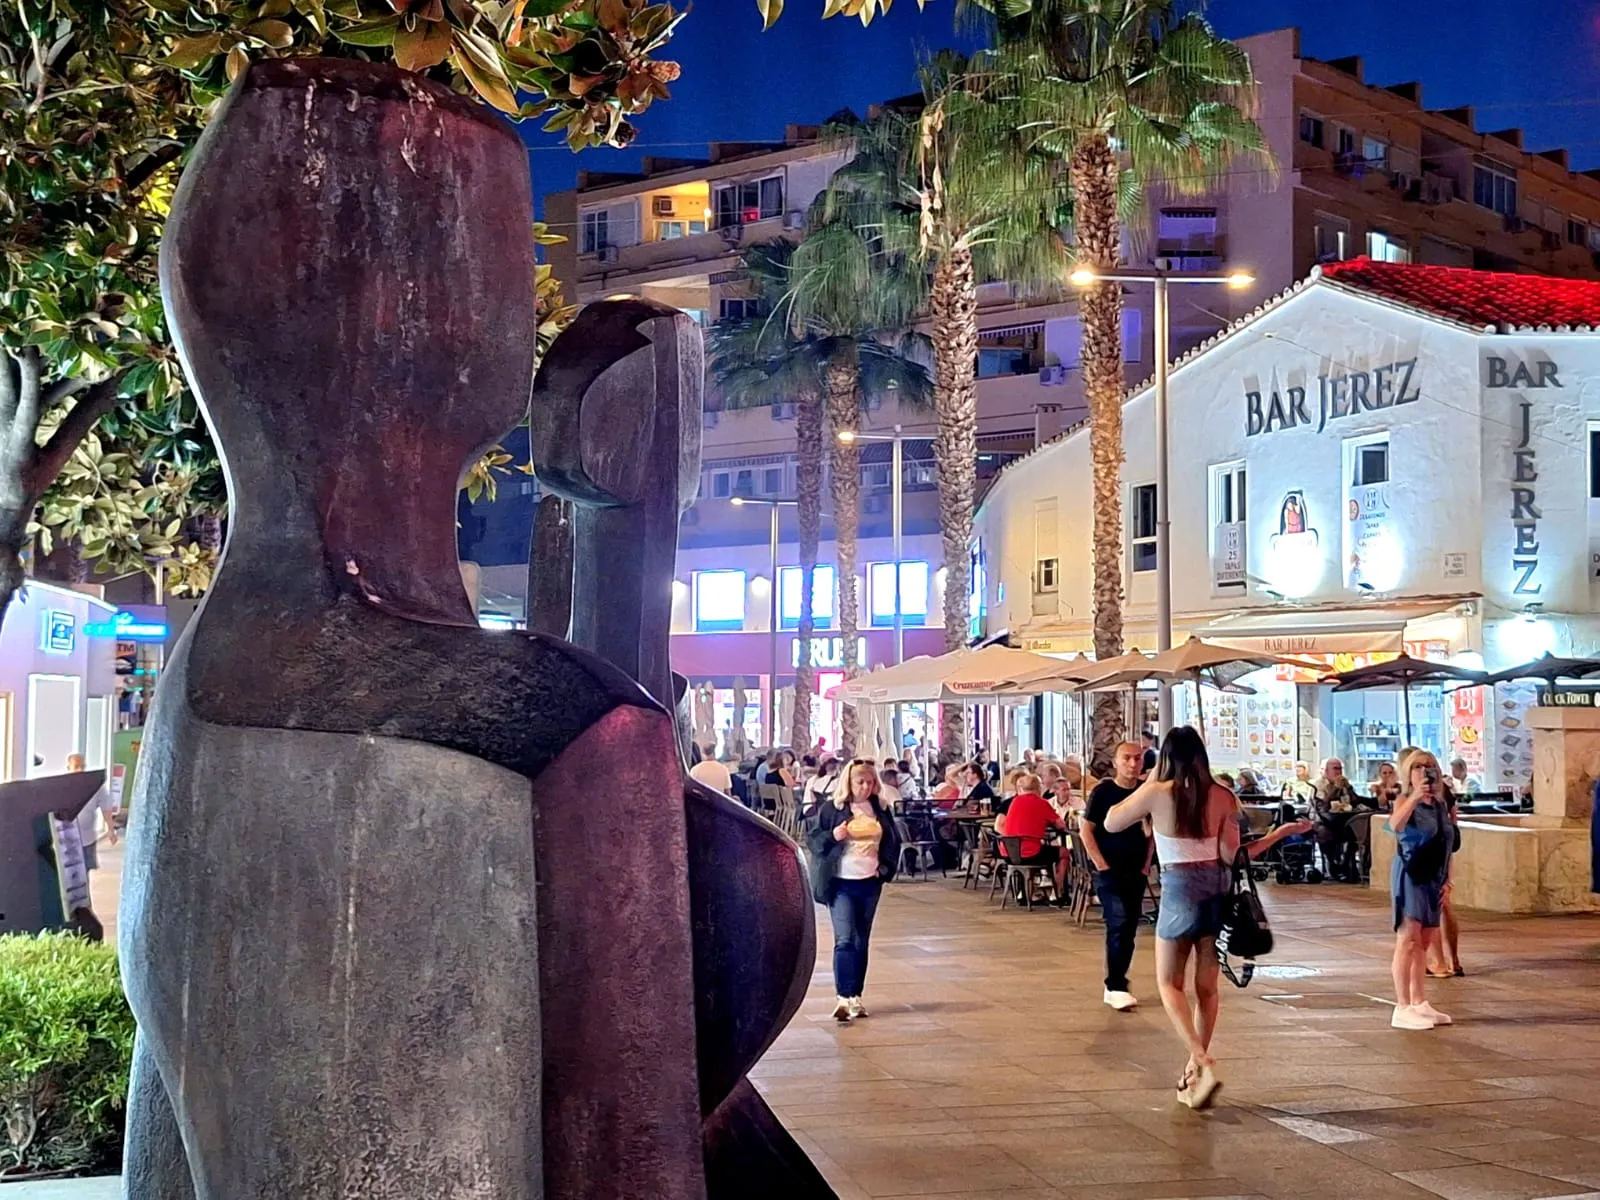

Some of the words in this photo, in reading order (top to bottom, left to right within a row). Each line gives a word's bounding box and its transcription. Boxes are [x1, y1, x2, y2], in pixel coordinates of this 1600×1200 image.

[1245, 386, 1312, 437] BAR
[1317, 356, 1421, 434] JEREZ
[1486, 356, 1564, 388] BAR
[1511, 402, 1542, 595] JEREZ
[791, 636, 867, 668] RUI
